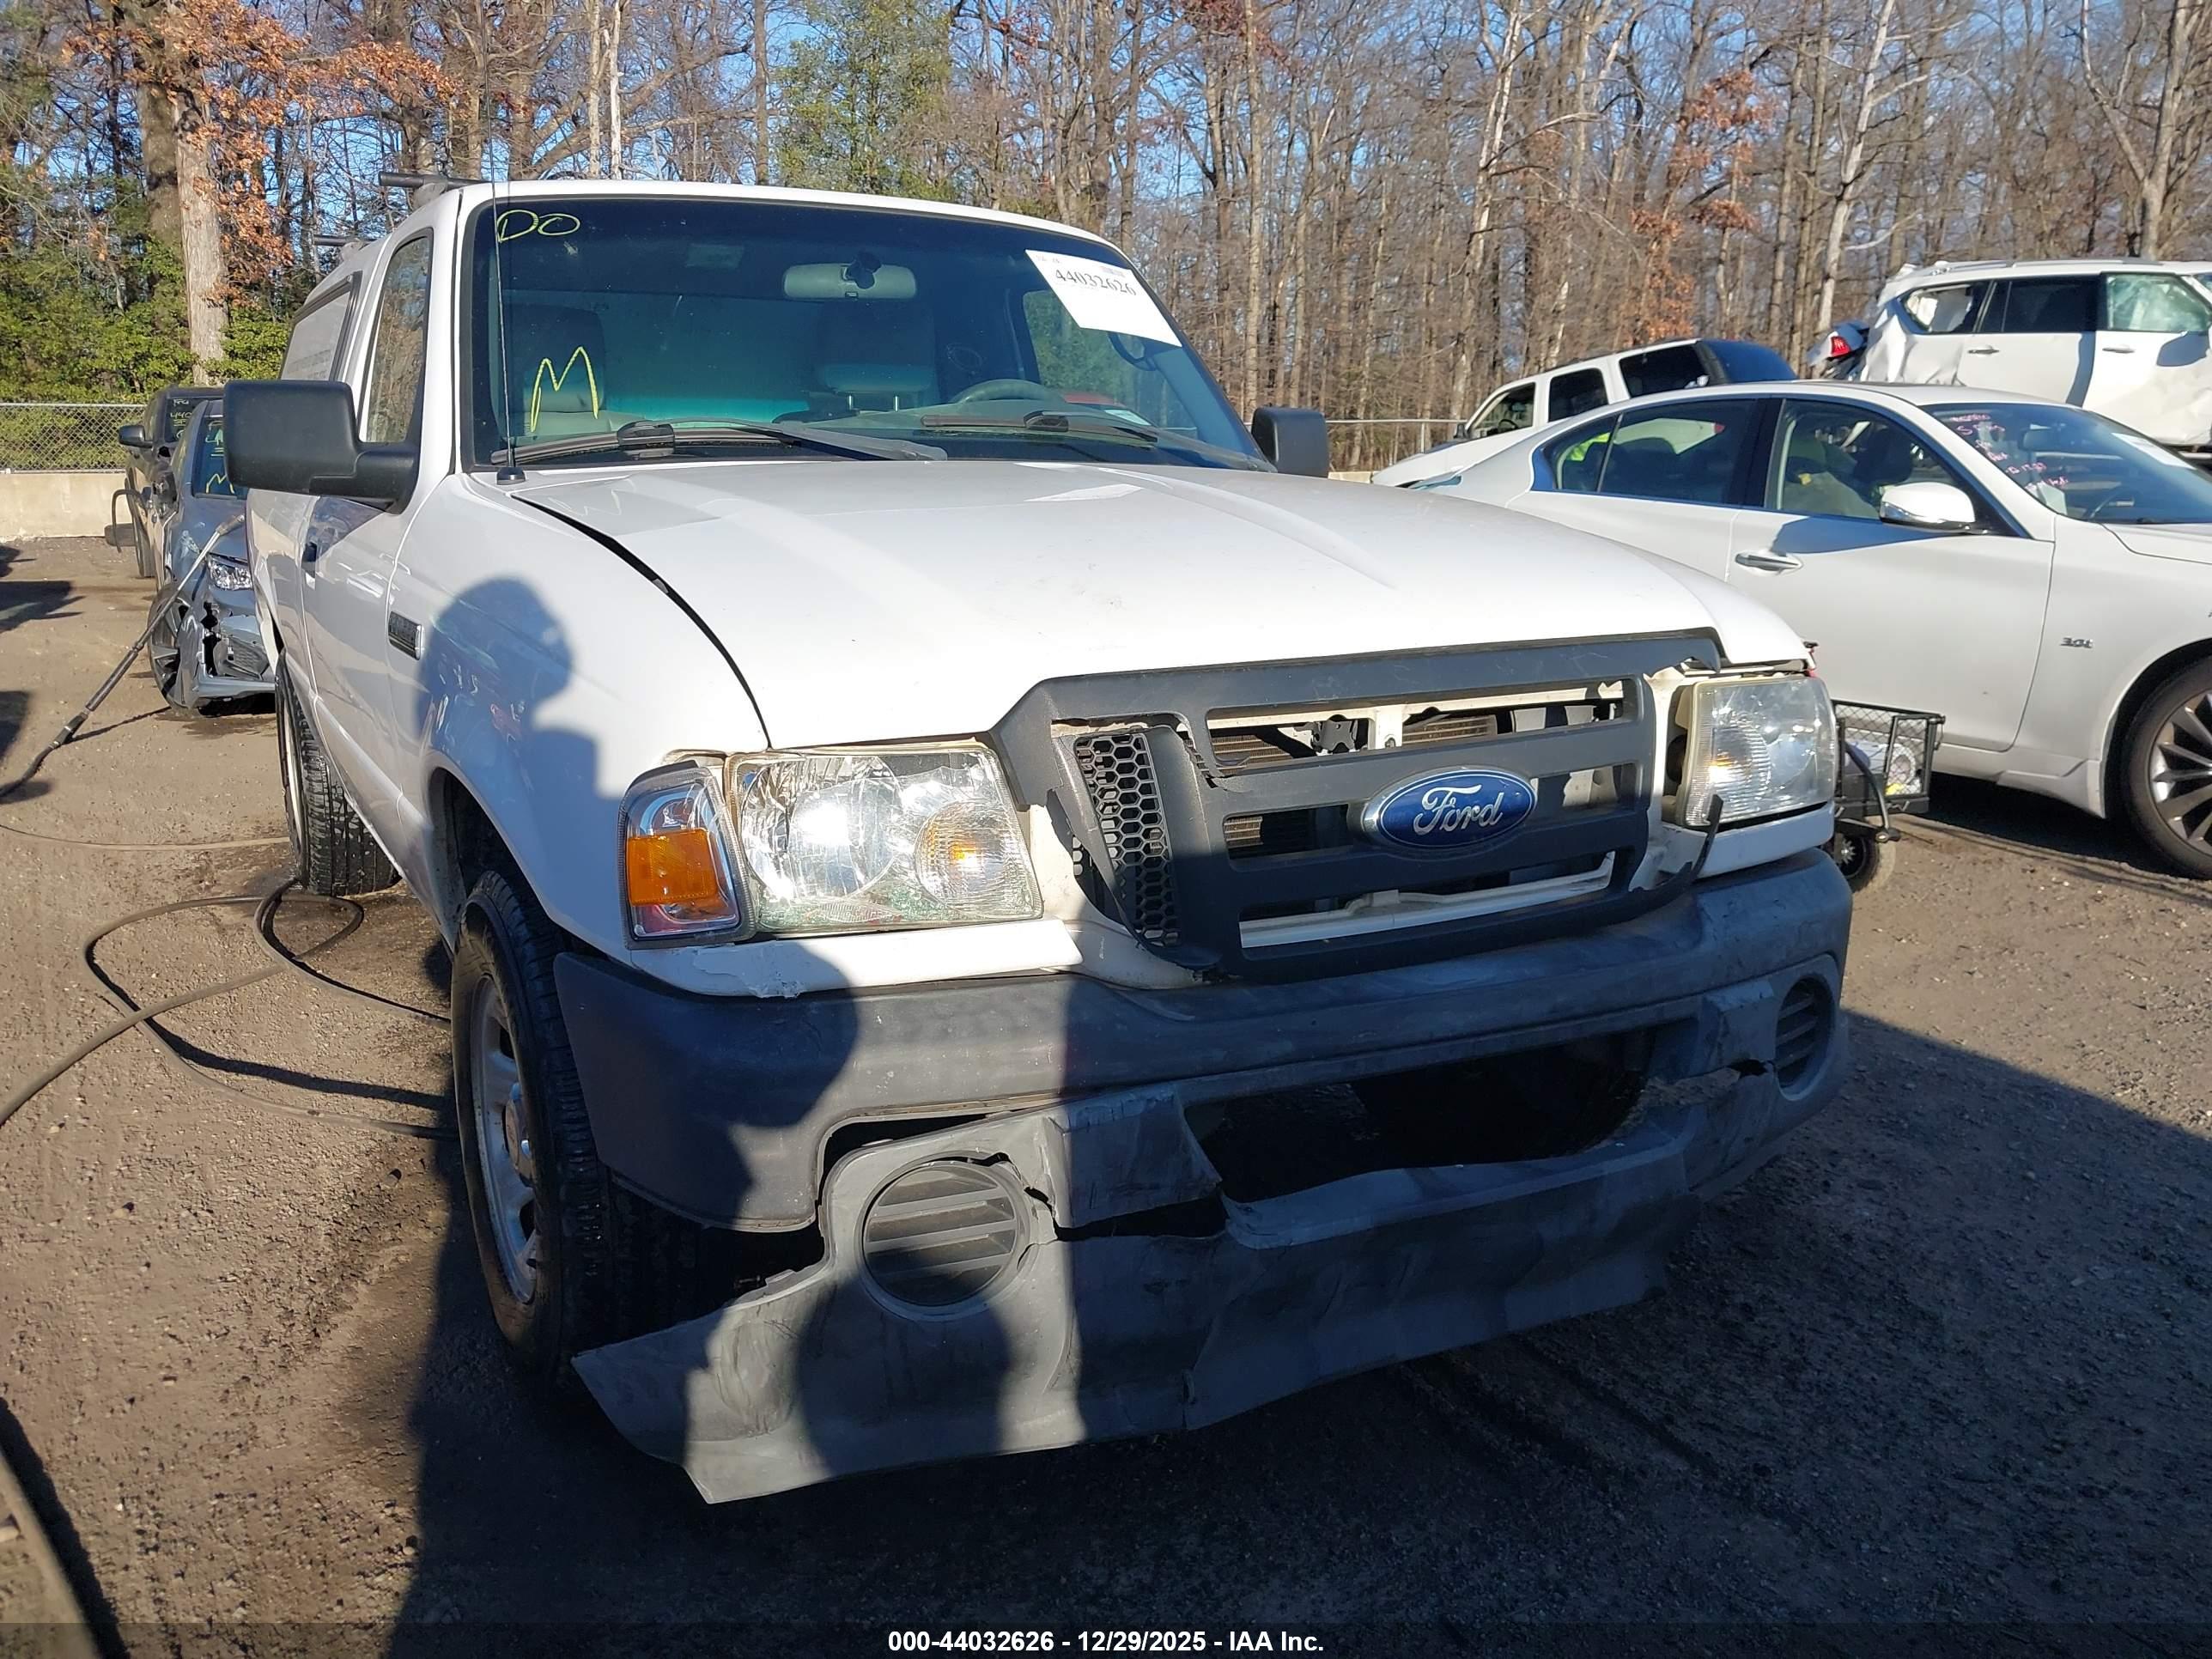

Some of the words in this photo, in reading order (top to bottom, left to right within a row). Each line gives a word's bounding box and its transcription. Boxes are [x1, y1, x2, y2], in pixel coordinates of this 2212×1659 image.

[1055, 269, 1137, 296] 44032626
[530, 345, 599, 432] M
[1413, 784, 1504, 836] Ford
